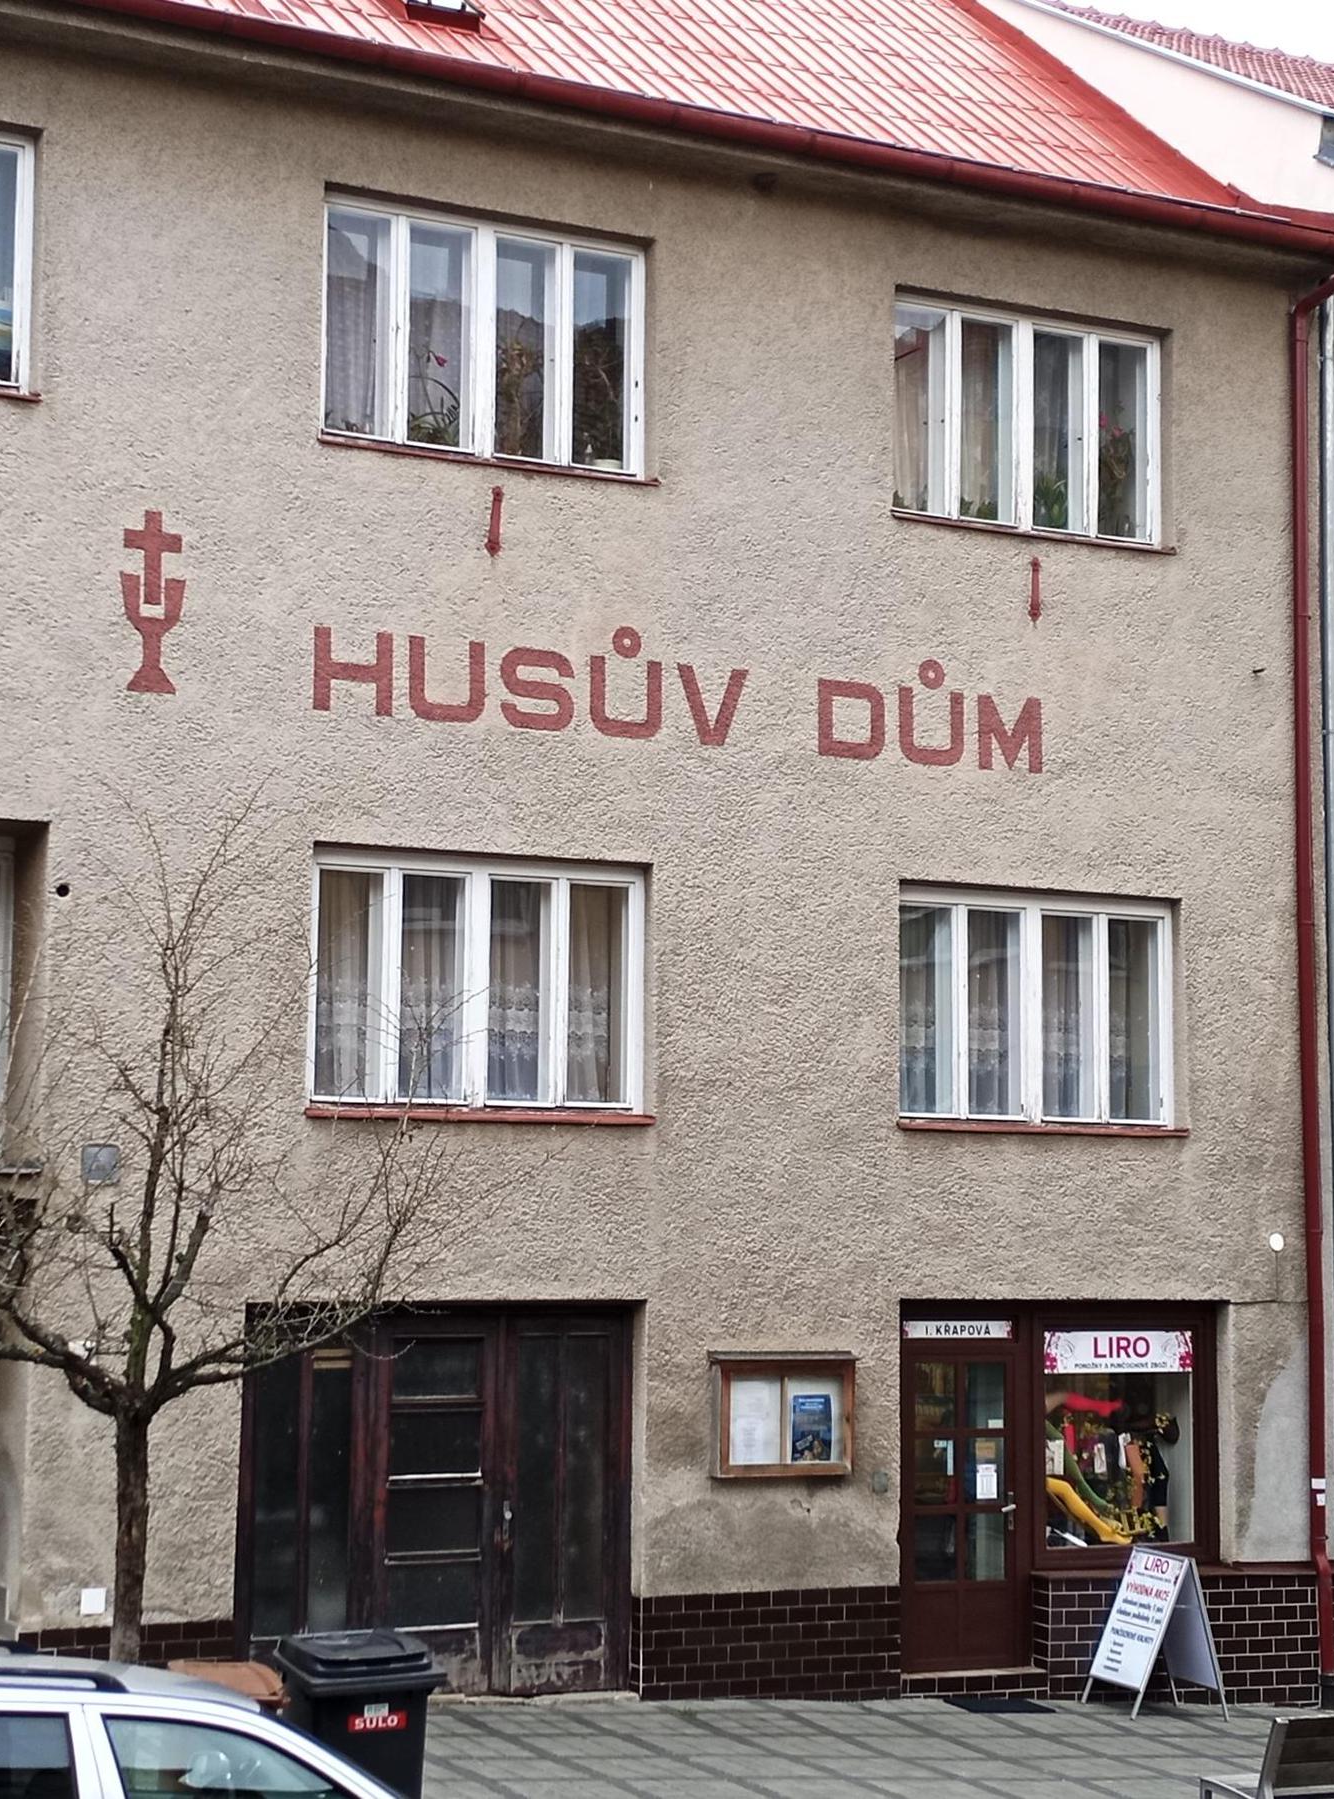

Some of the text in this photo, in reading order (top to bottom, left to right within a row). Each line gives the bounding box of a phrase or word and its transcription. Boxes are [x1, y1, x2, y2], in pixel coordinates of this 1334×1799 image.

[312, 625, 1043, 774] HUSŮV DŮM
[935, 1322, 992, 1336] KŘAPOVÁ
[1093, 1336, 1151, 1359] LIRO
[1144, 1555, 1170, 1575] LIRO
[354, 1714, 398, 1730] SULO
